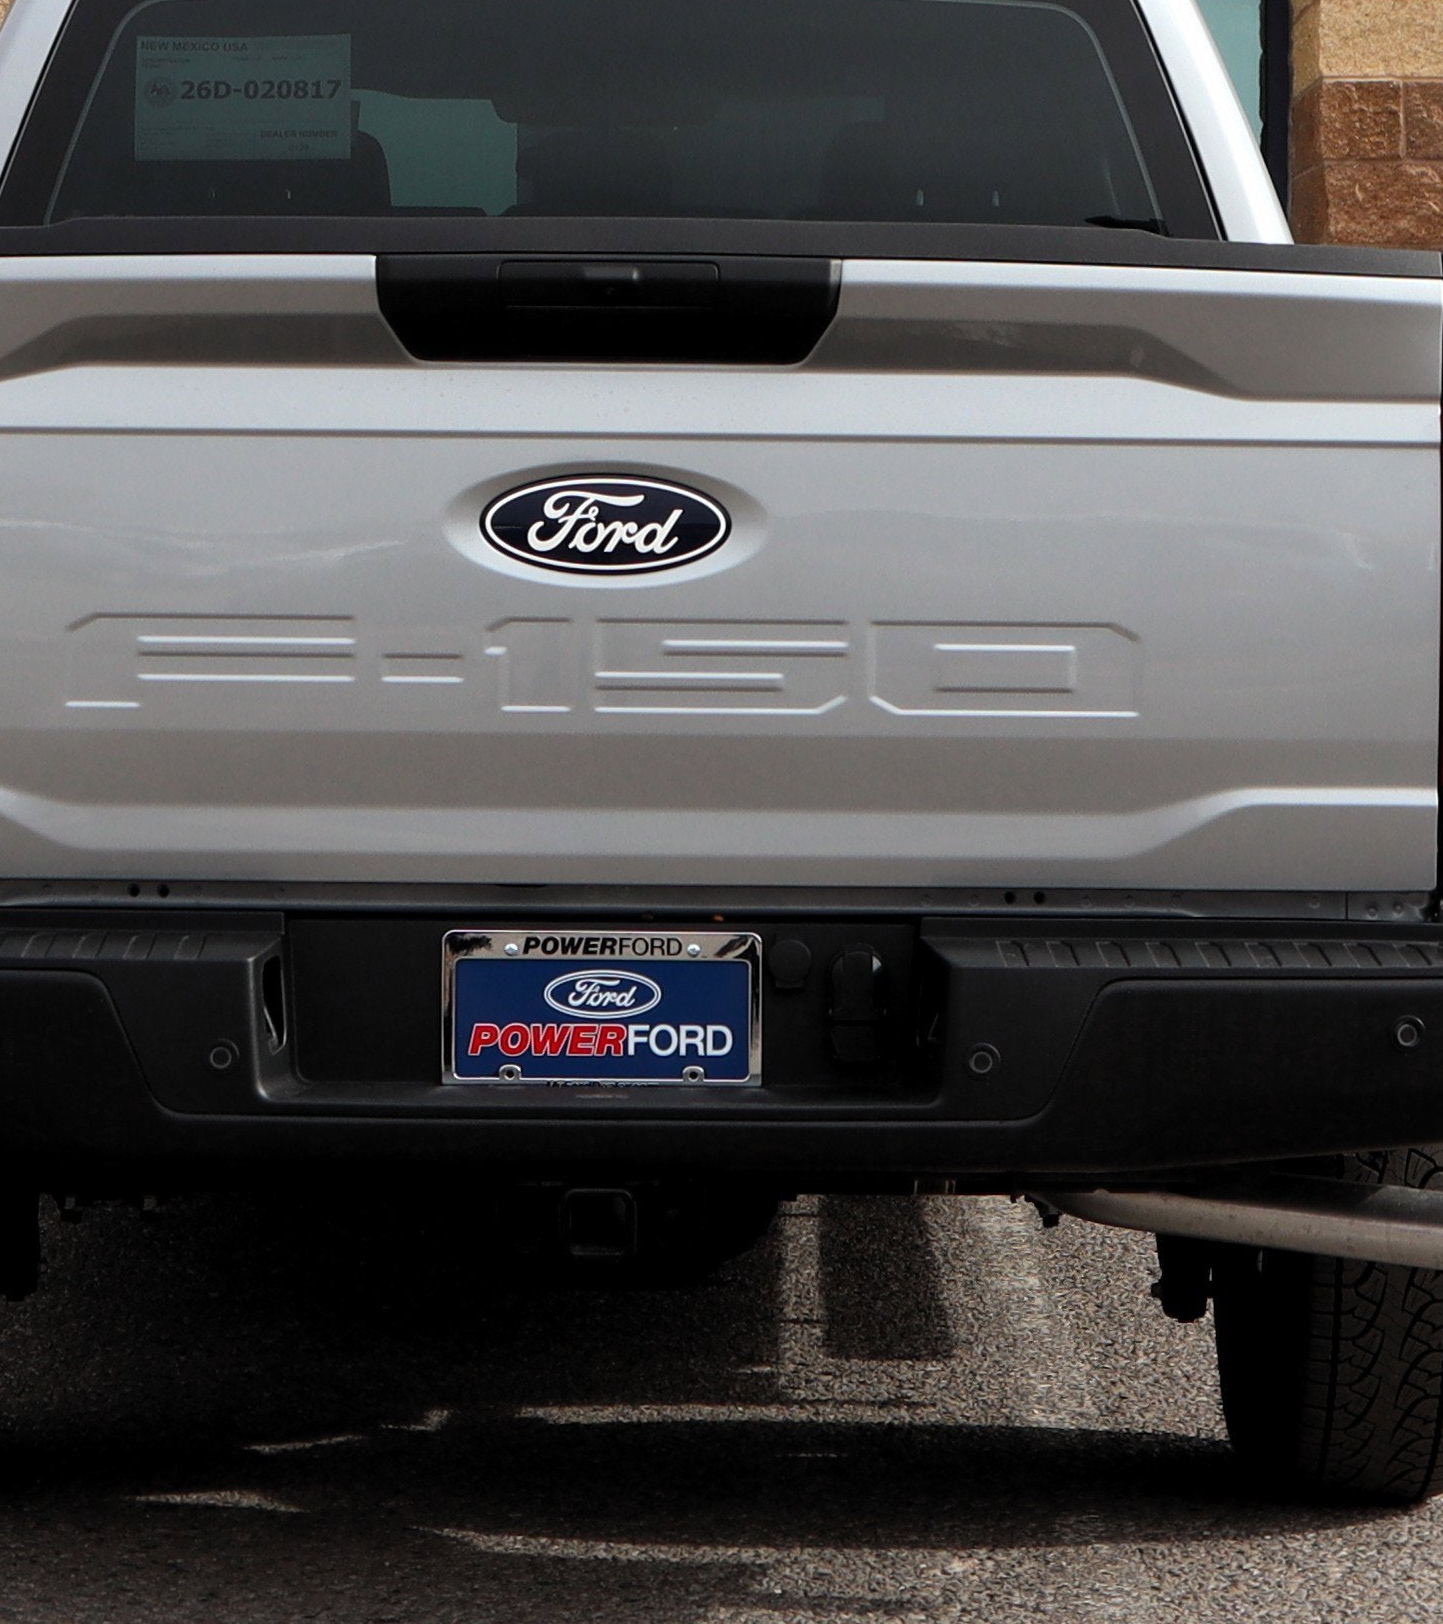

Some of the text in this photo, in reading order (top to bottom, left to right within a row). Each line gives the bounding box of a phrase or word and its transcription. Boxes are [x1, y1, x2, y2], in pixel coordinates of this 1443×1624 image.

[140, 40, 248, 52] NEW MEXICO USA
[180, 79, 342, 100] 26D-020817
[528, 489, 683, 557] Ford
[64, 611, 1143, 719] F-150
[522, 935, 683, 957] POWERFORD
[567, 978, 638, 1008] Ford
[467, 1022, 734, 1057] POWERFORD
